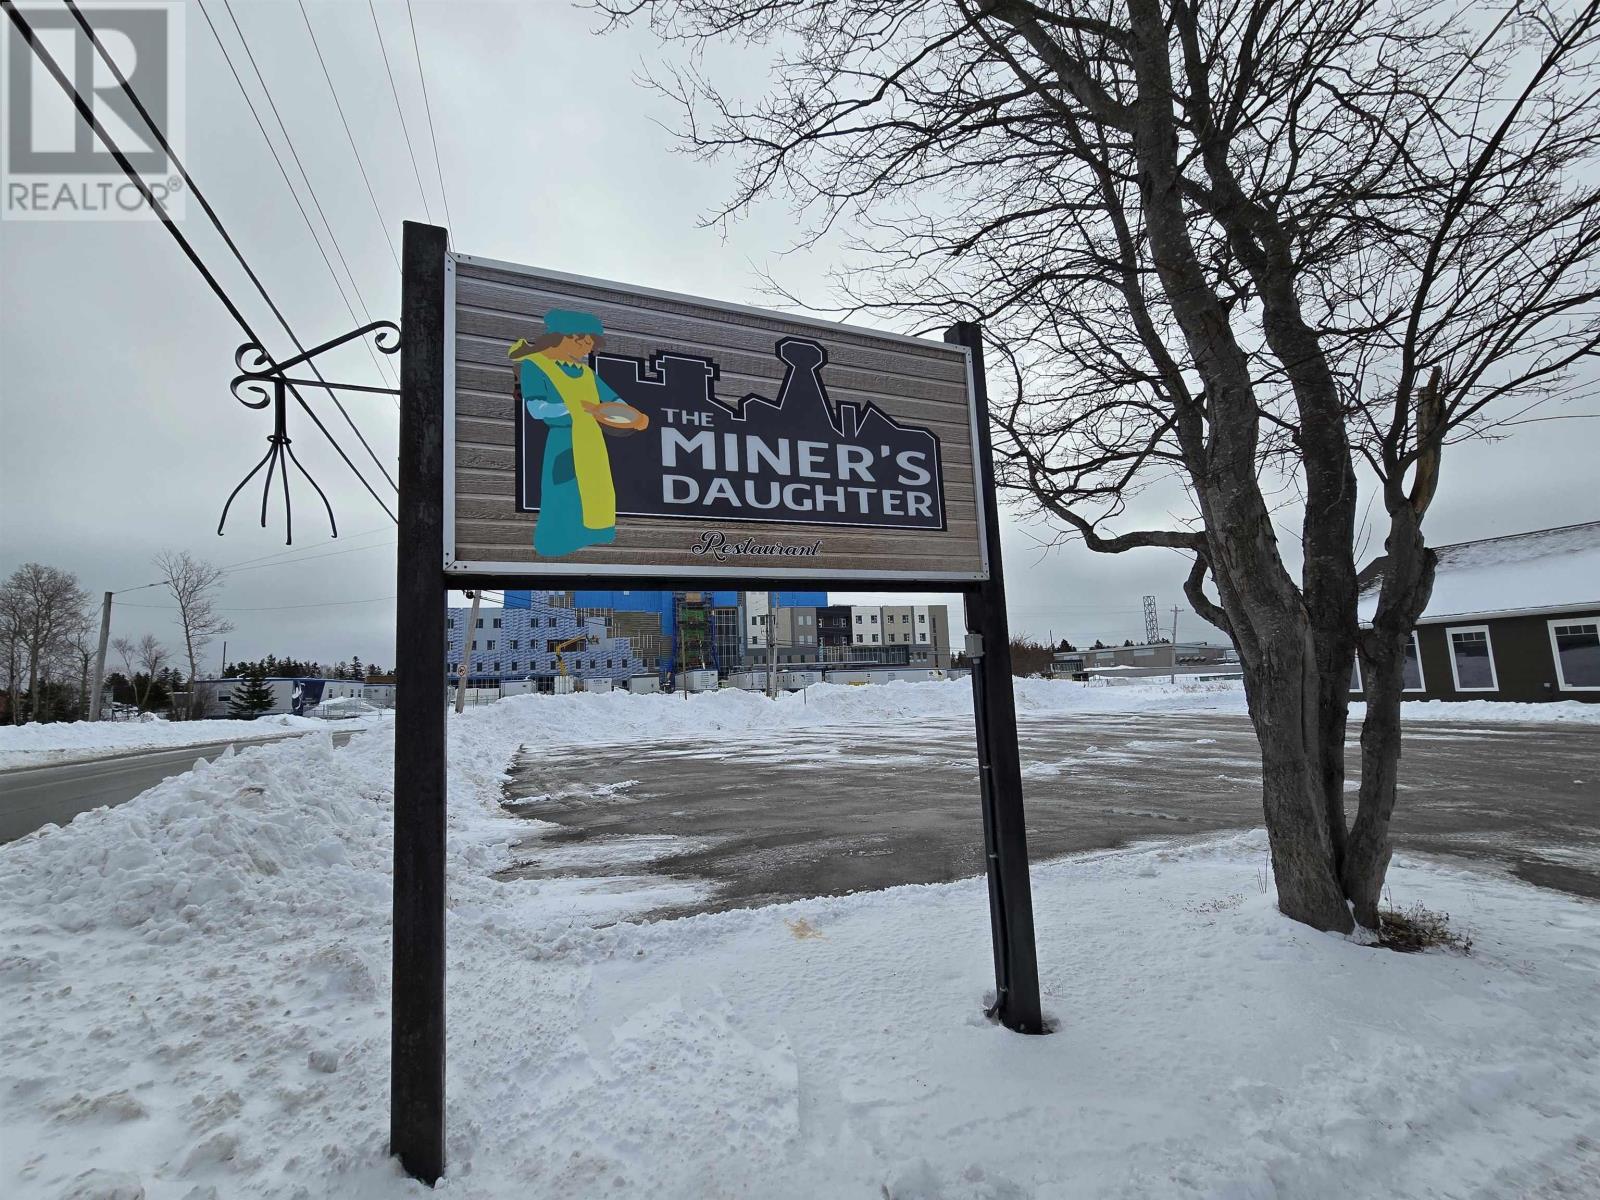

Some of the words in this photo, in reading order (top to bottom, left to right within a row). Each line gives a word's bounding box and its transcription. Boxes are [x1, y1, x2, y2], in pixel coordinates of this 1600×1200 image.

[660, 408, 715, 427] THE
[660, 427, 932, 486] MINER'S
[662, 474, 933, 517] DAUGHTER
[691, 530, 822, 562] Restaurant
